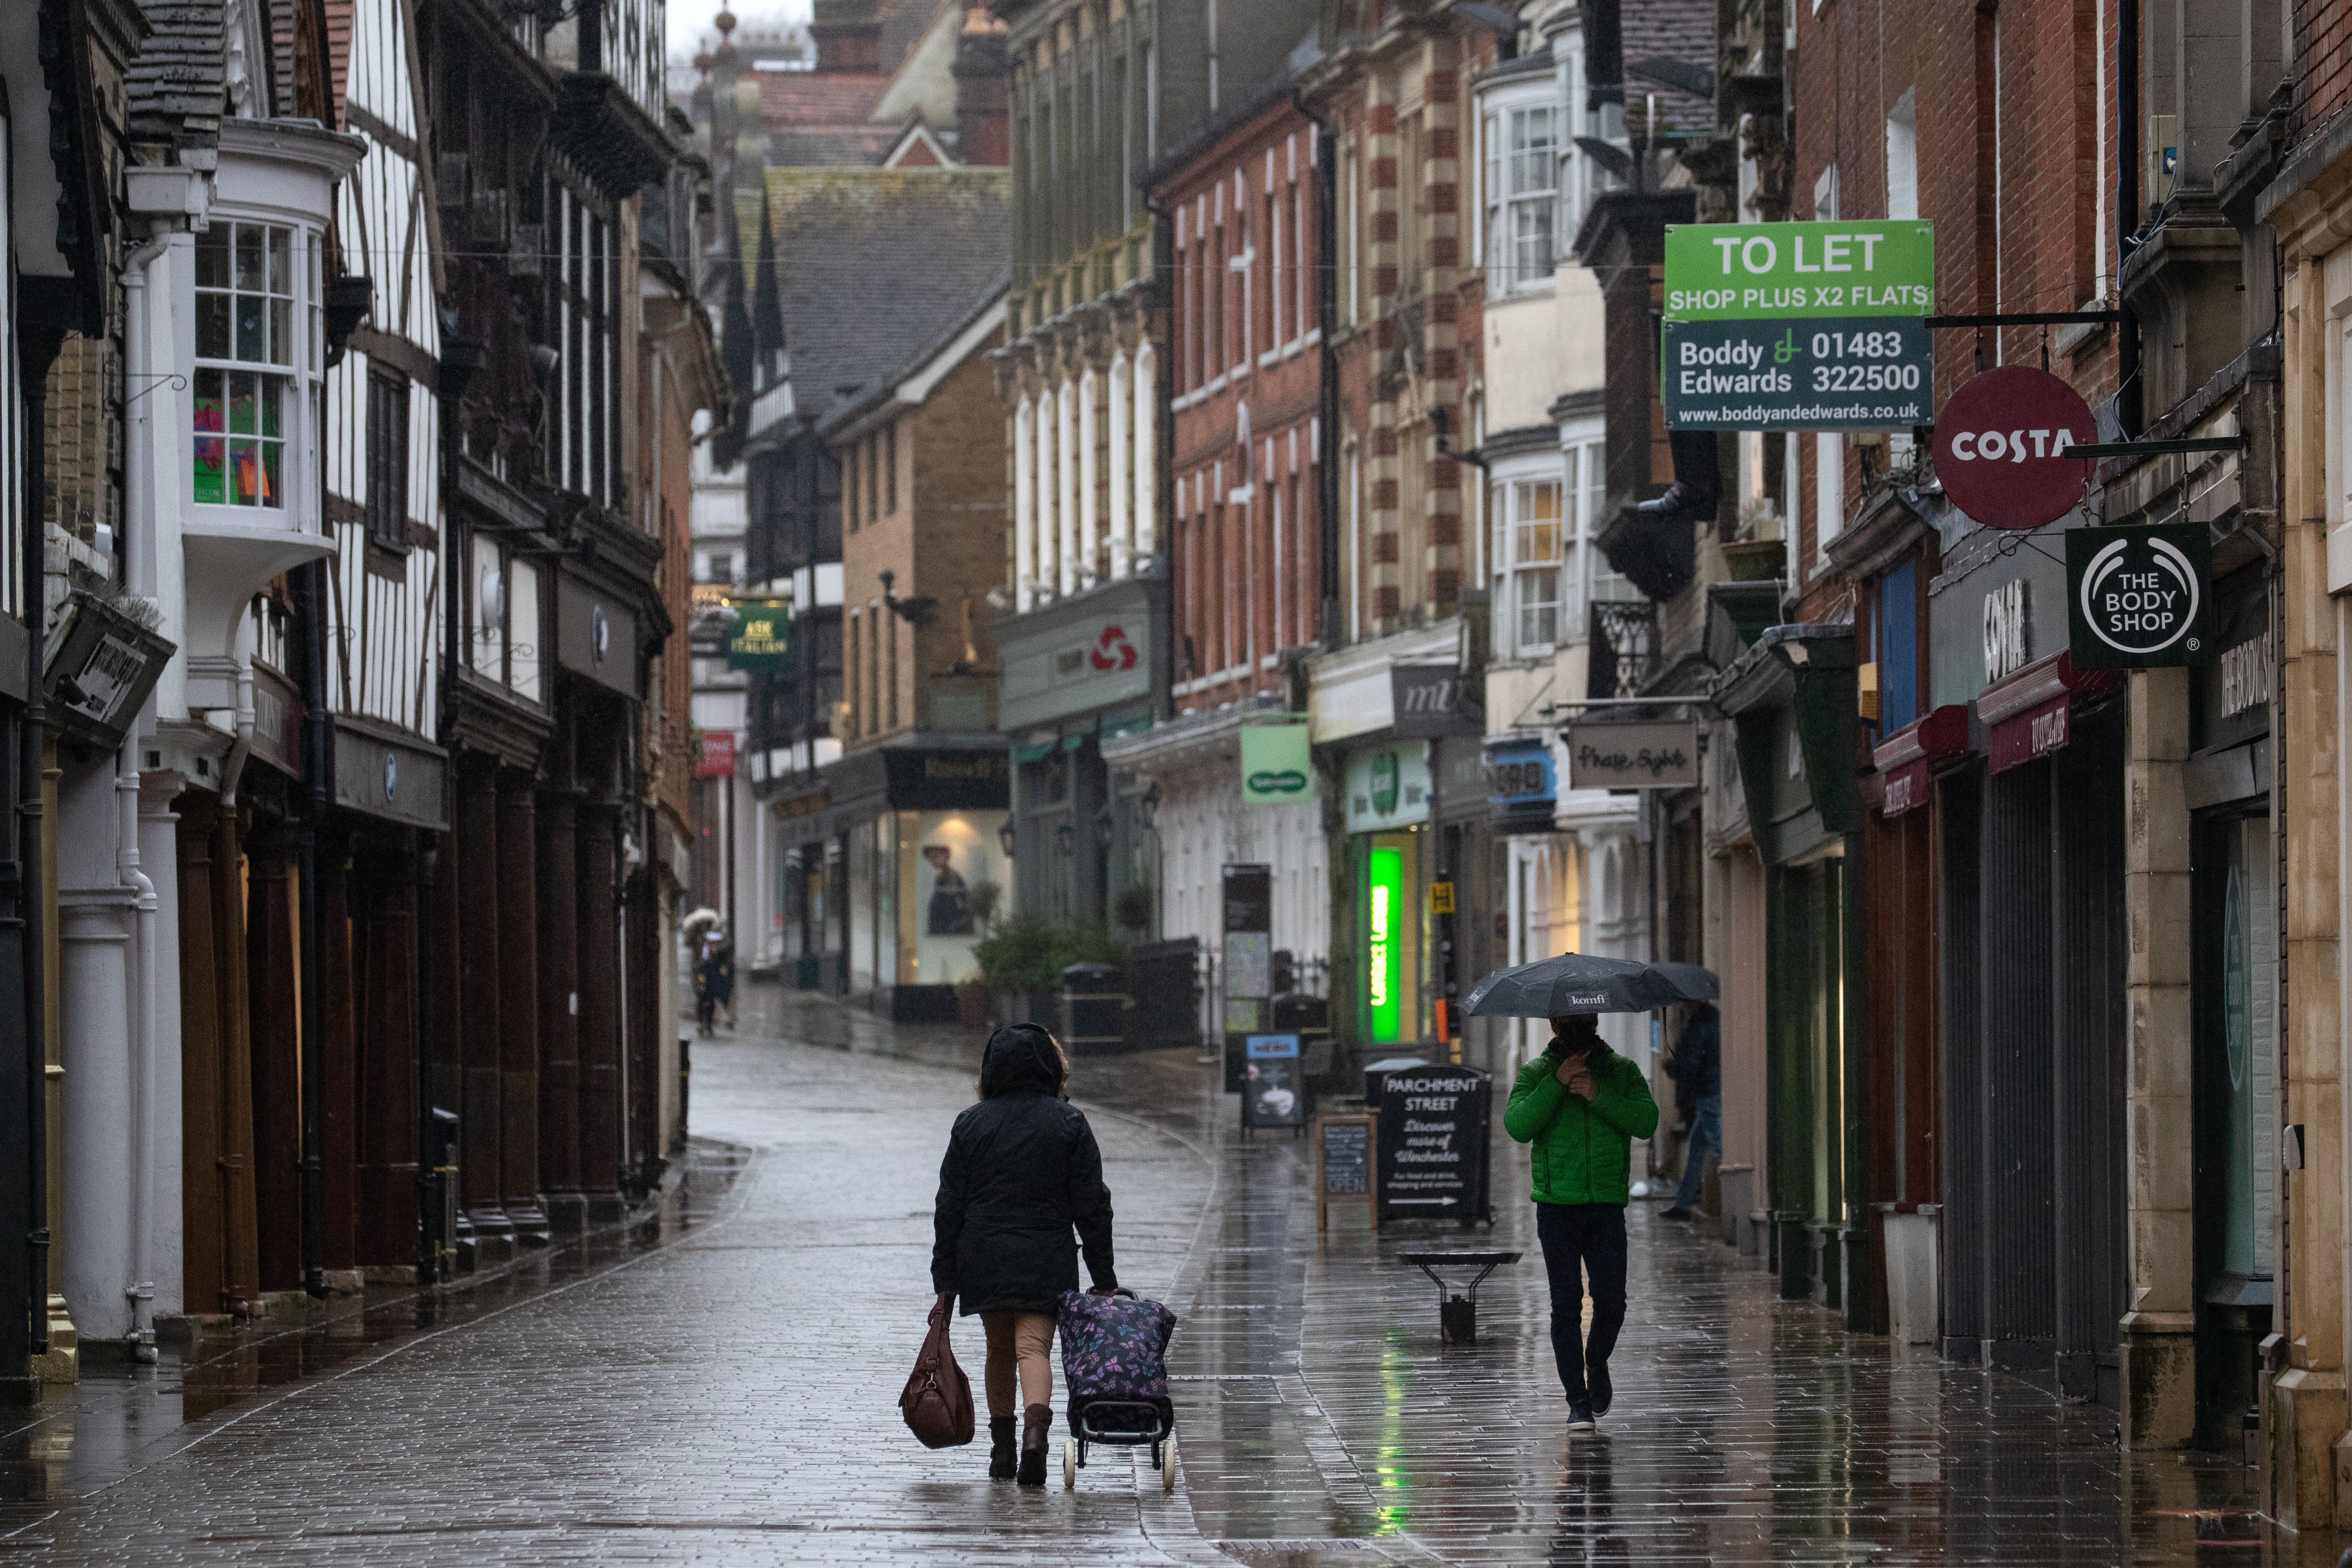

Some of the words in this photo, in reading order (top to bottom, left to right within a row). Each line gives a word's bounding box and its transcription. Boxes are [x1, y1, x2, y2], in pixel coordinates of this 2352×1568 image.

[1713, 236, 1777, 274] TO
[1794, 233, 1884, 273] LET
[1670, 289, 1736, 311] SHOP
[1743, 287, 1807, 309] PLUS
[1814, 286, 1844, 307] X2
[1852, 285, 1929, 306] FLATS
[1680, 339, 1763, 370] Boddy
[1812, 332, 1902, 360] 01483
[1680, 368, 1792, 395] Edwards
[1812, 364, 1920, 392] 322500
[1679, 402, 1919, 425] www.boddyandedwards.co.uk
[1951, 428, 2076, 463] COSTA
[2118, 572, 2160, 590] THE
[2106, 590, 2177, 612] BODY
[2110, 612, 2174, 632] SHOP
[1572, 994, 1605, 1004] komfi
[1387, 1078, 1479, 1092] PARCHMENT
[1404, 1097, 1458, 1111] STREET
